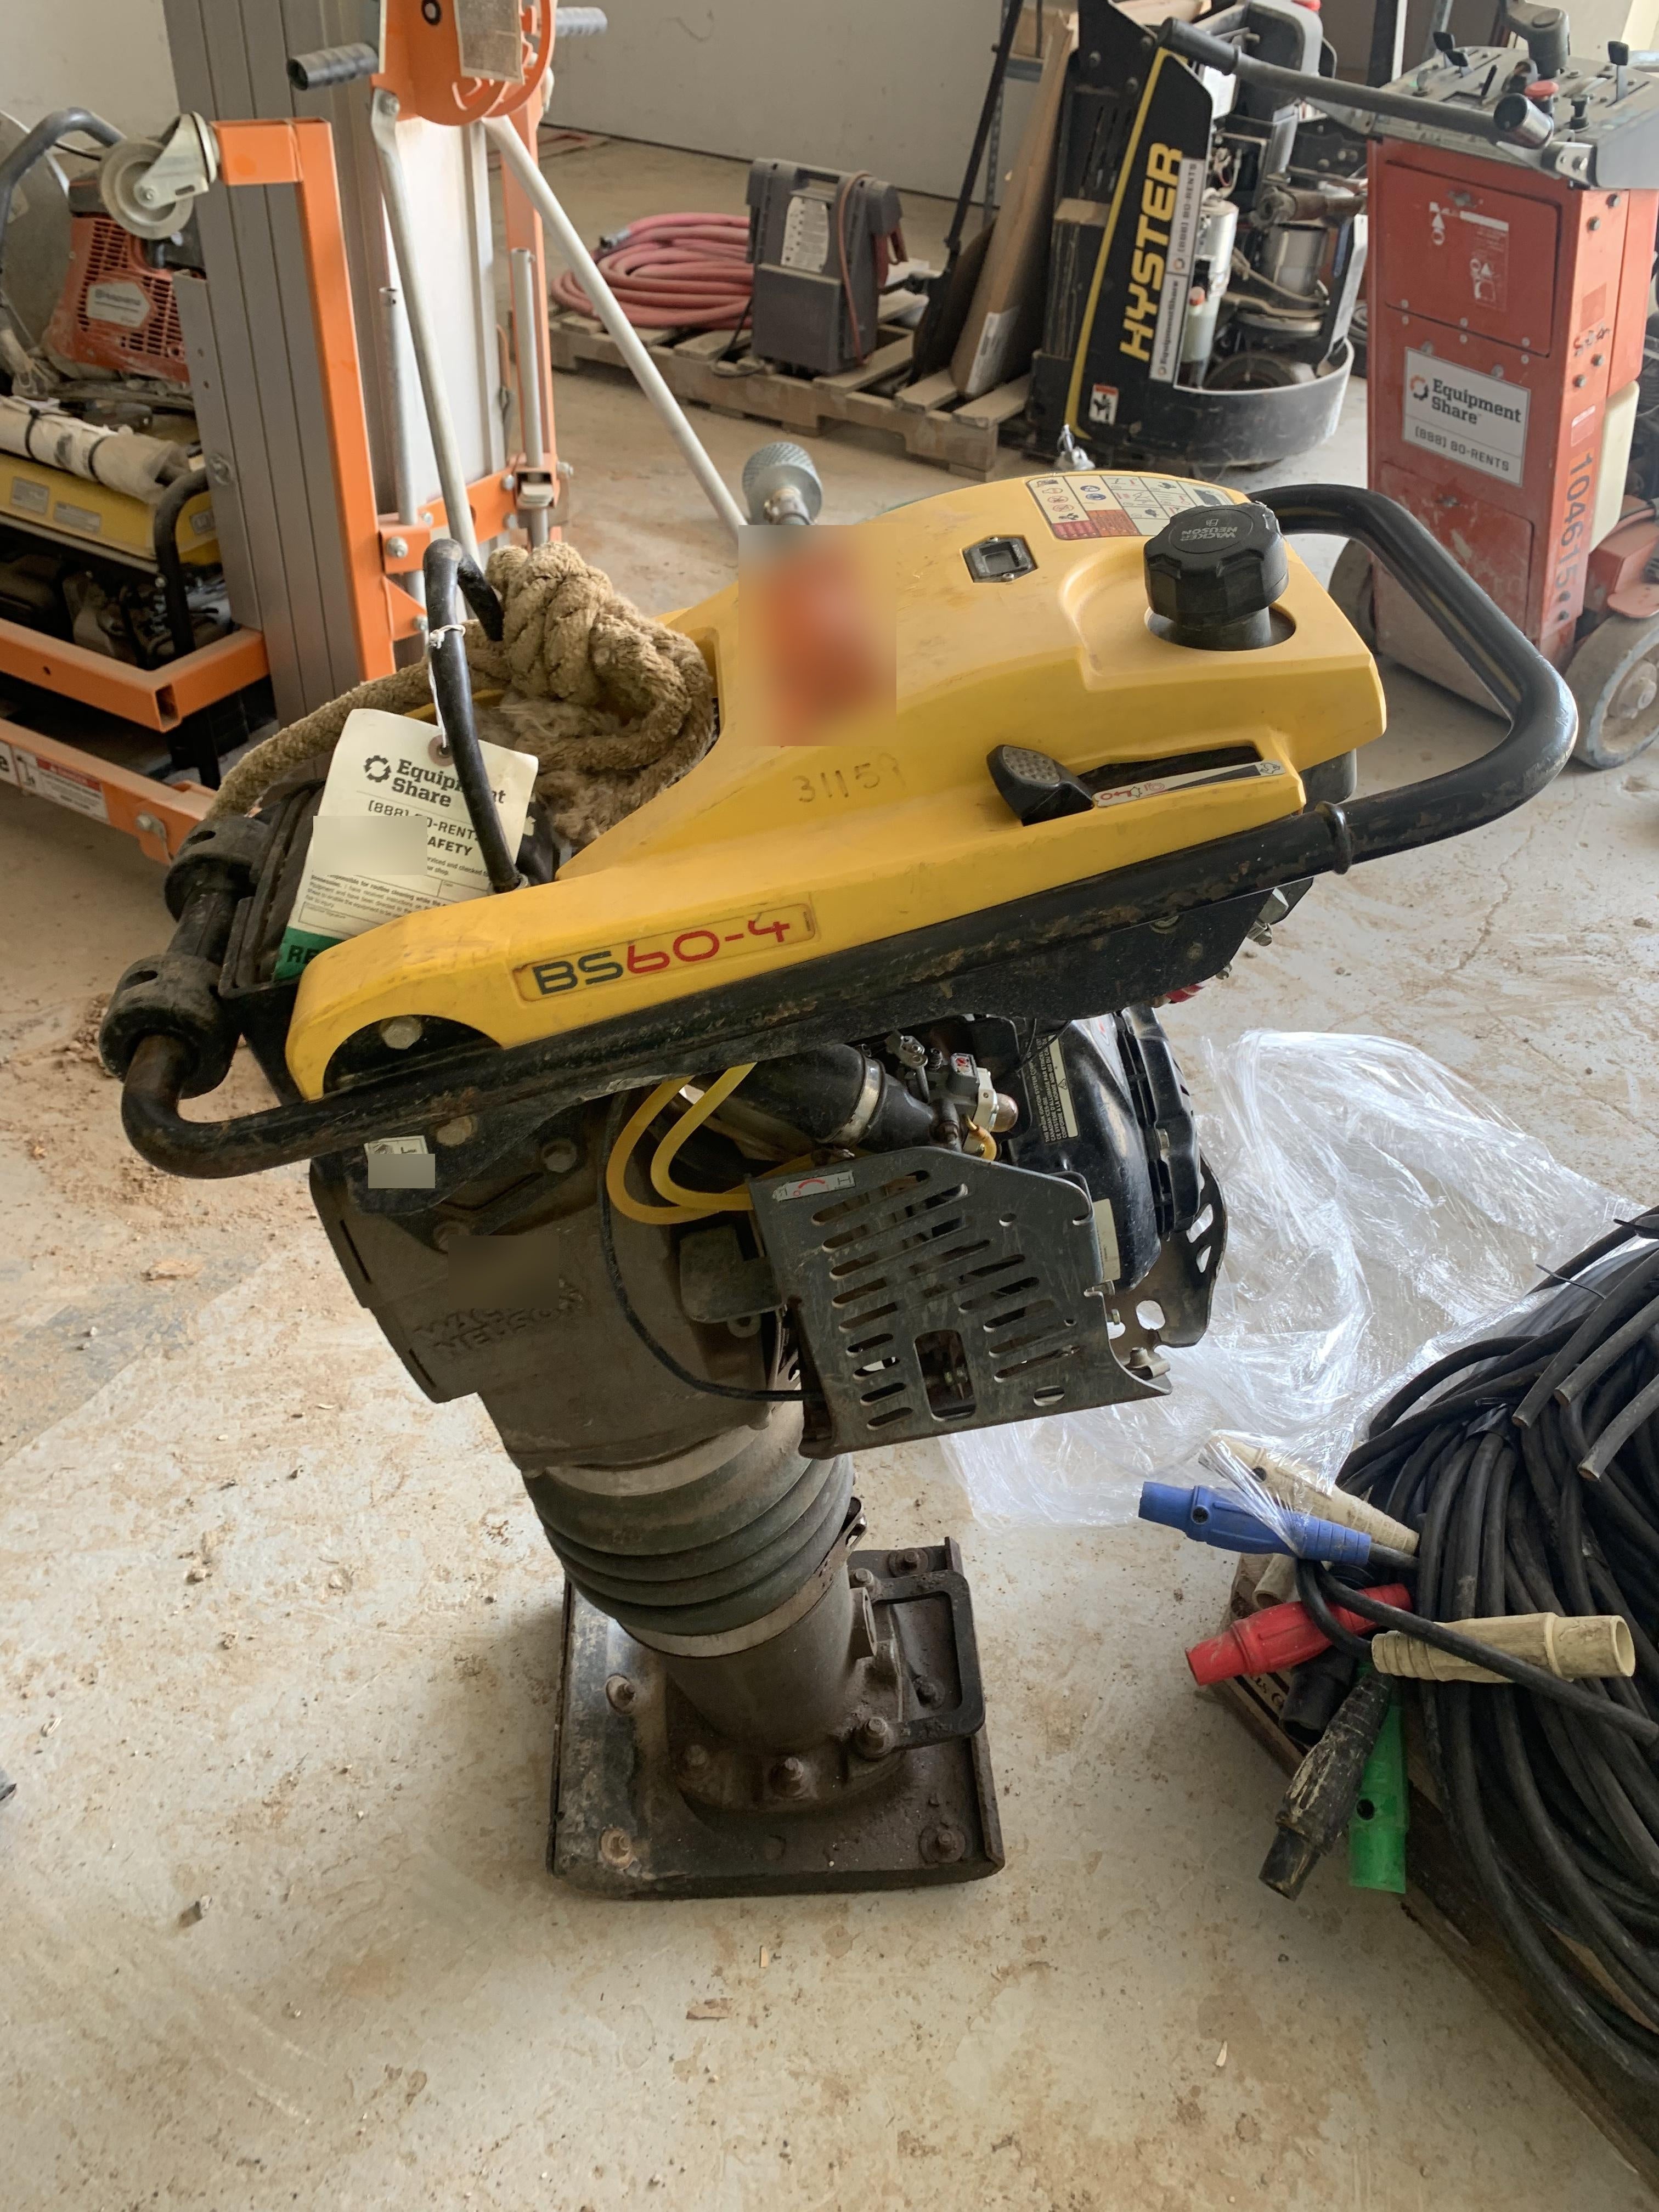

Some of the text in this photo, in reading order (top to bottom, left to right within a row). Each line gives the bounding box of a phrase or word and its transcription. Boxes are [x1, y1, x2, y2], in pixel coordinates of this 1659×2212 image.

[1120, 142, 1183, 362] HYSTER
[1159, 280, 1179, 365] EquipmentShare
[1431, 396, 1478, 425] Share
[1432, 377, 1522, 423] Equipment
[1415, 426, 1509, 471] (888) 80-RENTS
[1181, 527, 1238, 535] NEUSON
[1555, 452, 1593, 589] 104615
[392, 777, 452, 807] Share
[397, 759, 506, 804] Equipt
[427, 836, 473, 856] AFETY
[532, 919, 790, 995] BS60-4
